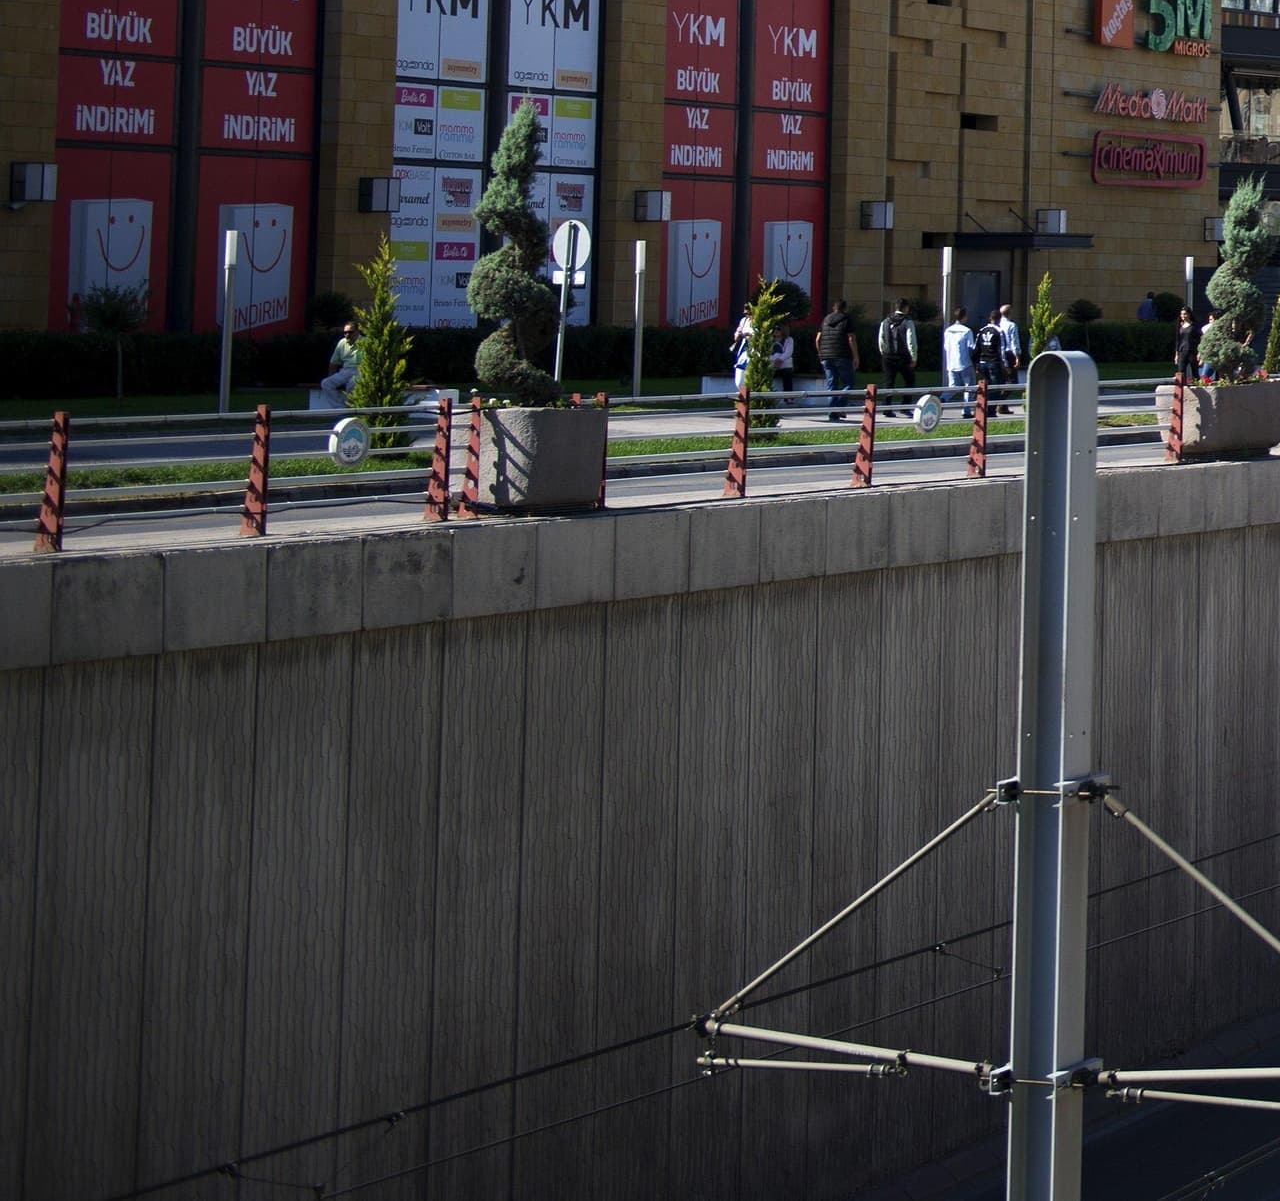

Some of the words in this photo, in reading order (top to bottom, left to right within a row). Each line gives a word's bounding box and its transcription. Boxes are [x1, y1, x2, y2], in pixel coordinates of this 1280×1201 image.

[86, 8, 153, 44] BÜYÜK
[232, 23, 293, 56] BÜYÜK
[673, 11, 726, 47] YKM
[768, 24, 818, 58] YKM
[100, 58, 136, 87] YAZ
[245, 70, 278, 97] YAZ
[676, 65, 720, 94] BÜYÜK
[772, 77, 812, 104] BÜYÜK
[1093, 82, 1152, 119] Media
[1163, 89, 1209, 123] Markt
[685, 106, 710, 131] YAZ
[780, 114, 802, 136] YAZ
